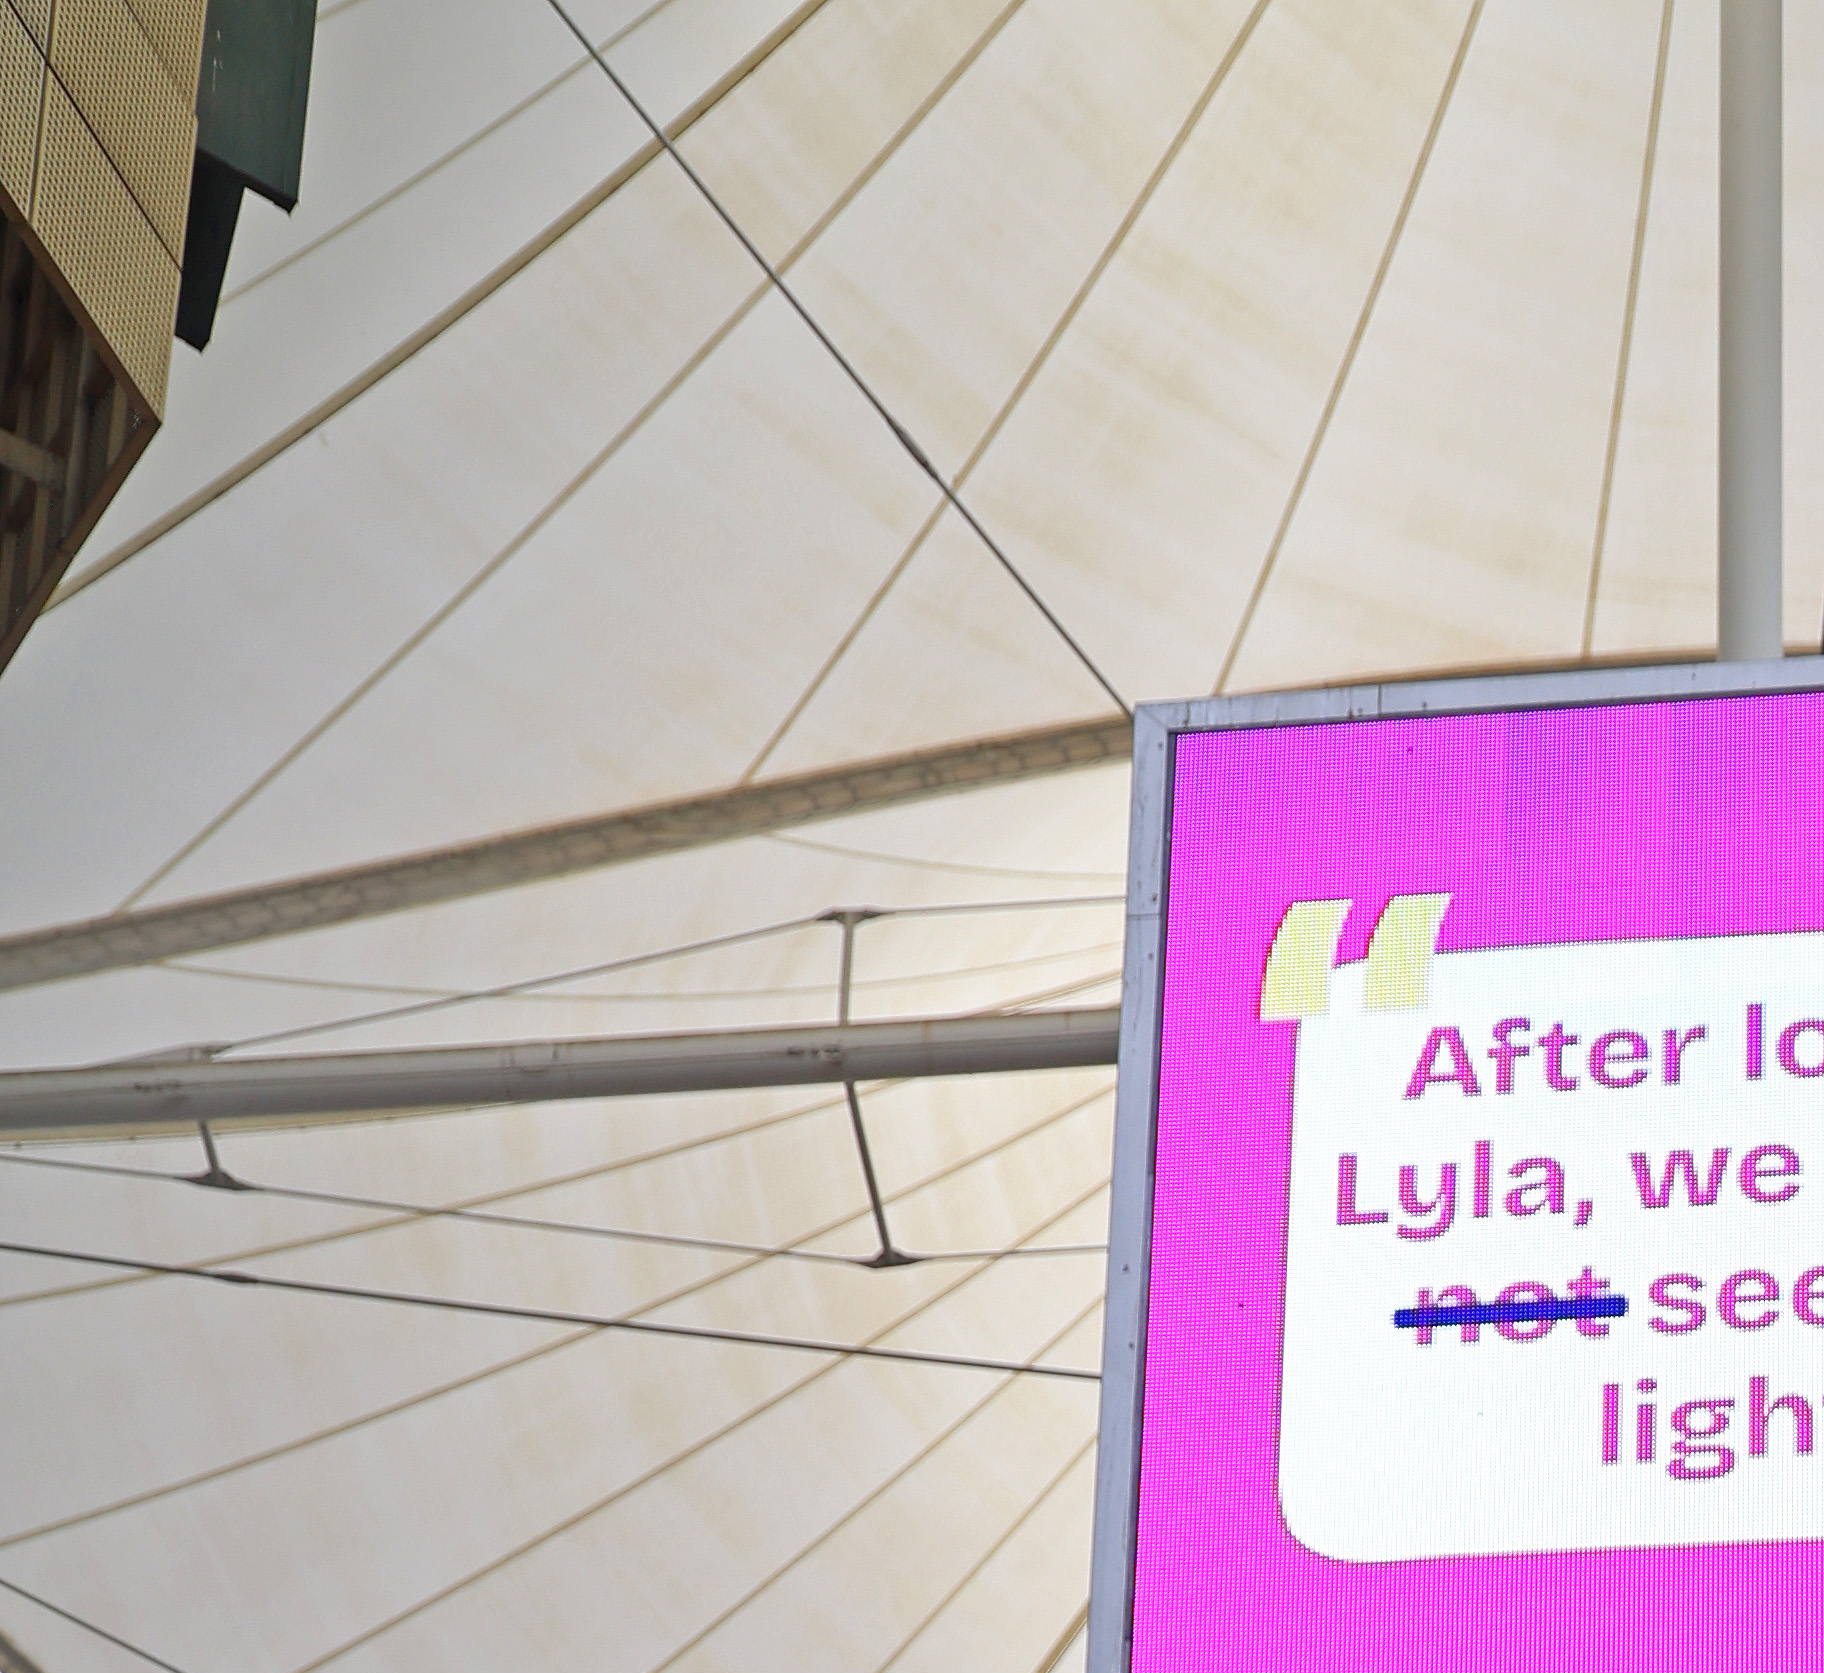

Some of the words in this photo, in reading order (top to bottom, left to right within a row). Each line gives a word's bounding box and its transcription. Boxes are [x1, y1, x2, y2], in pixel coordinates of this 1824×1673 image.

[1404, 1014, 1709, 1101] After
[1336, 1138, 1594, 1240] Lyla,
[1630, 1142, 1801, 1210] we
[1410, 1264, 1613, 1346] not
